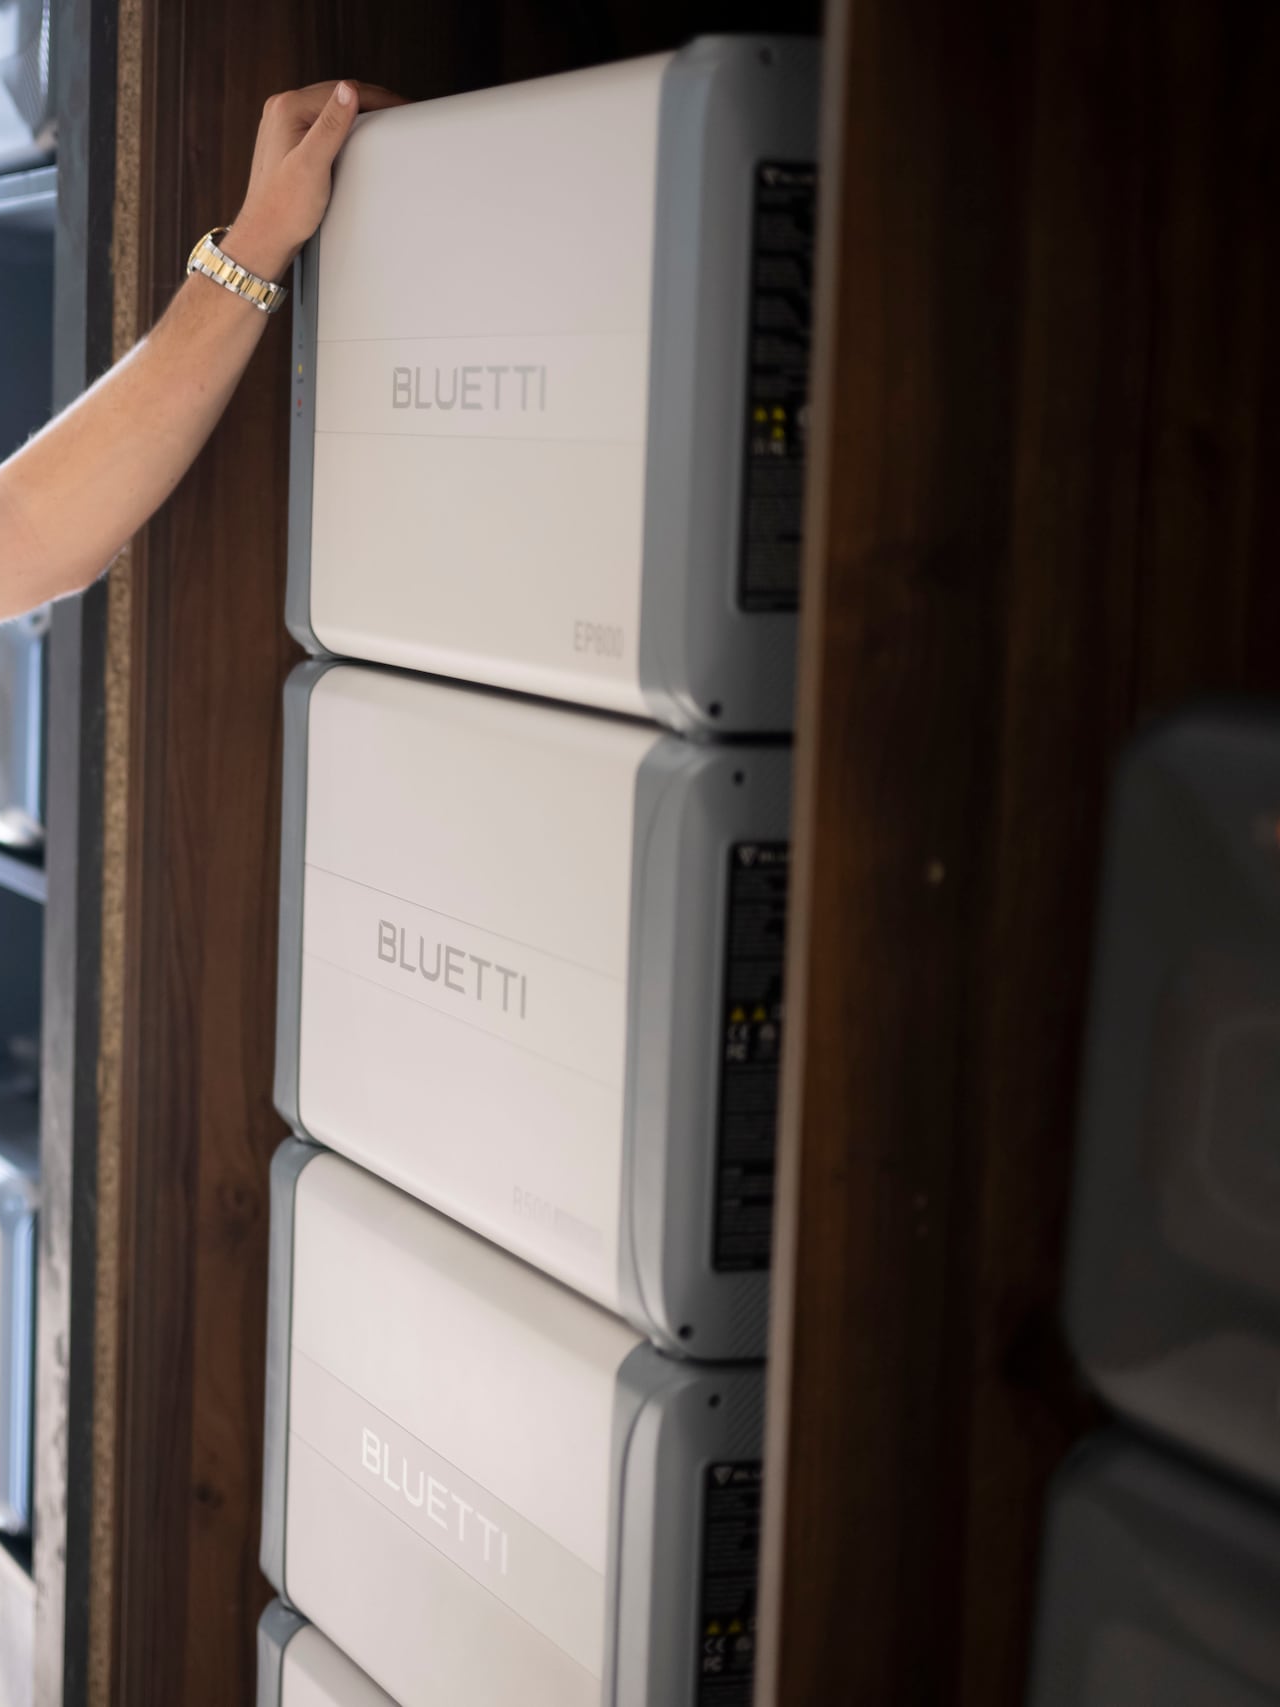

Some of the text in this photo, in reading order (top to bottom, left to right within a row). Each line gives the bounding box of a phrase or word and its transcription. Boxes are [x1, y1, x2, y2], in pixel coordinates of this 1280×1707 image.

[392, 365, 547, 411] BLUETTI
[378, 919, 527, 1020] BLUETTI
[362, 1426, 508, 1575] BLUETTI
